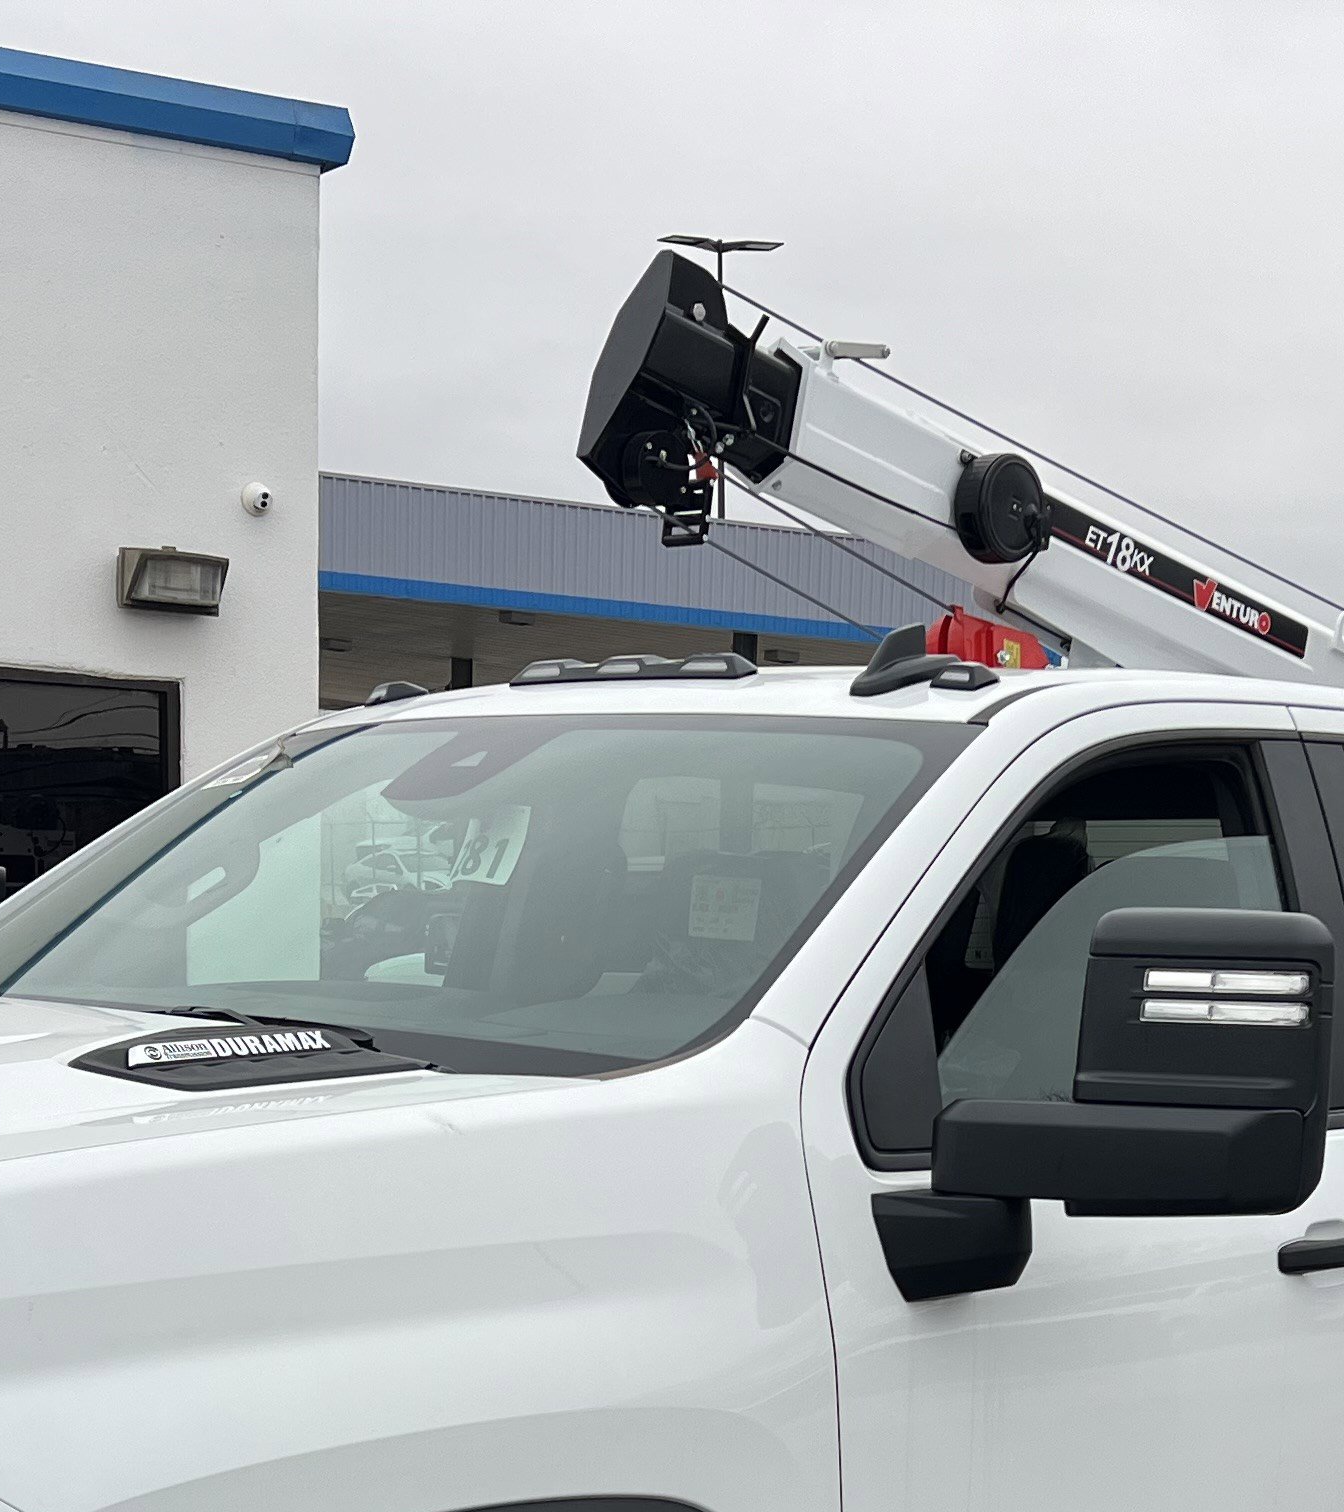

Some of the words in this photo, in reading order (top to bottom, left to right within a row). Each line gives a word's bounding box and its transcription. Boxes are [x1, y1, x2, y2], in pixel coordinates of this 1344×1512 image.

[1193, 579, 1271, 635] VENTURO
[161, 1042, 209, 1053] Allison
[207, 1030, 332, 1058] DURAMAX
